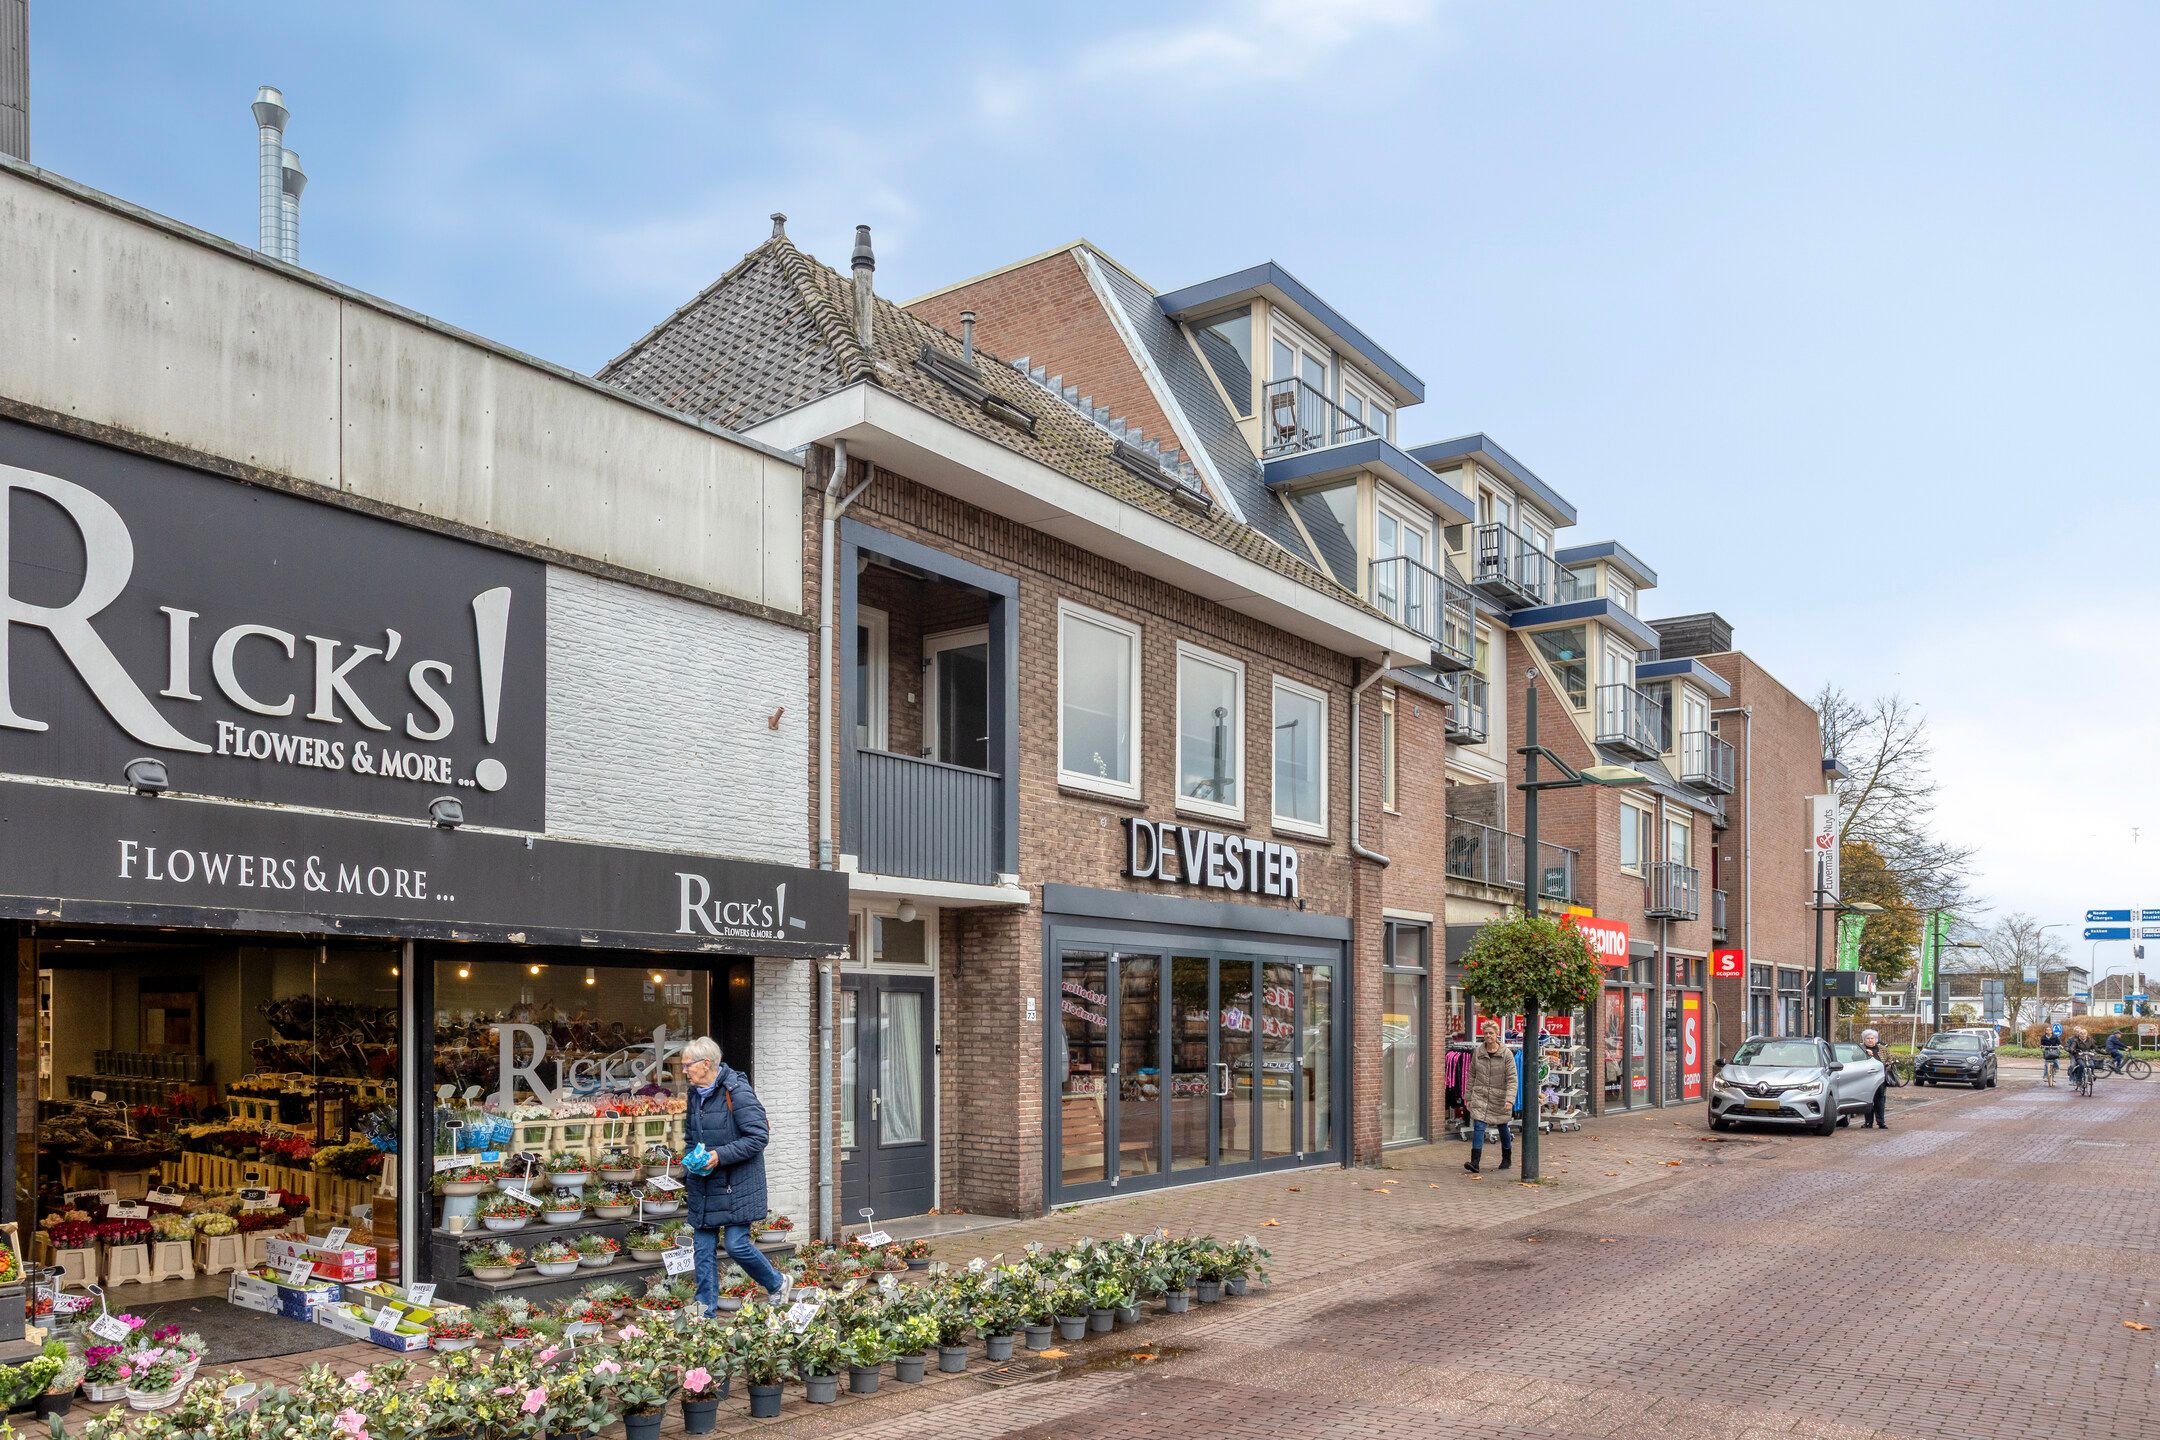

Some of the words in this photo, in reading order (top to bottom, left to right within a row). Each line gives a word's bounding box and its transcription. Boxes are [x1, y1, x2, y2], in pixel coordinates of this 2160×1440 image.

[216, 720, 345, 770] FLOWERS
[352, 741, 376, 774] &
[1824, 809, 1835, 833] Nuyts
[117, 839, 297, 890] FLOWERS
[303, 855, 331, 893] &
[1824, 850, 1833, 890] Euverman
[1721, 954, 1736, 971] S
[1632, 1077, 1647, 1089] scapino
[1684, 1073, 1701, 1089] capino
